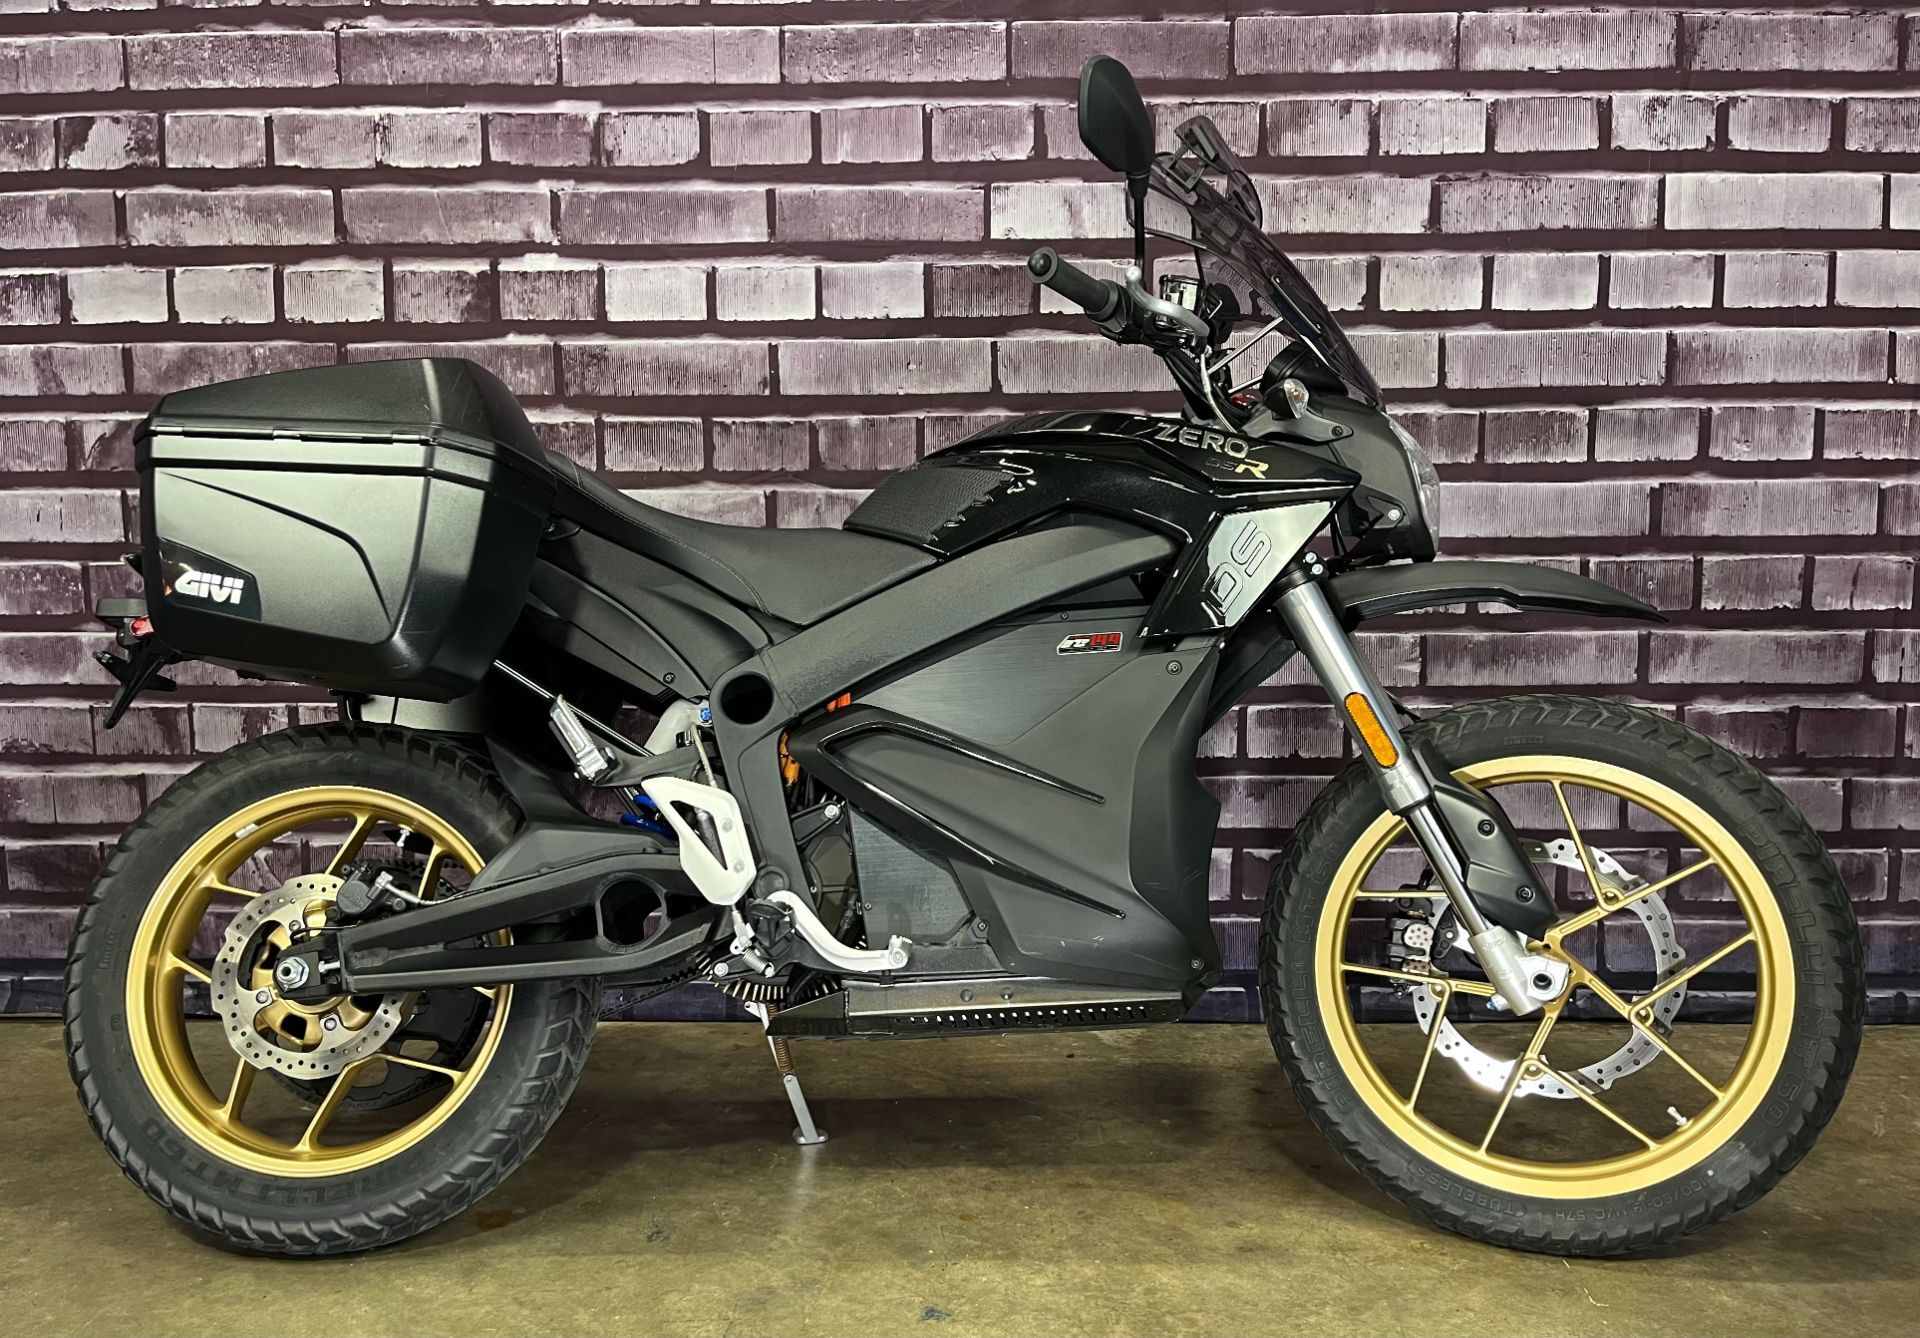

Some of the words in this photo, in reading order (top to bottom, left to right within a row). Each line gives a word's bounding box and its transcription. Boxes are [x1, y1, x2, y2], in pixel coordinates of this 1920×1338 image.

[1154, 422, 1249, 458] ZERO
[175, 570, 245, 604] GIVI
[1202, 520, 1272, 616] DS
[1310, 836, 1345, 885] 60
[1292, 887, 1318, 944] MT
[1736, 817, 1825, 985] PIRELLI
[1291, 962, 1358, 1114] PIRELLI
[1791, 1005, 1825, 1069] MT
[1760, 1070, 1806, 1128] 60
[1415, 1168, 1516, 1214] TUBELESS
